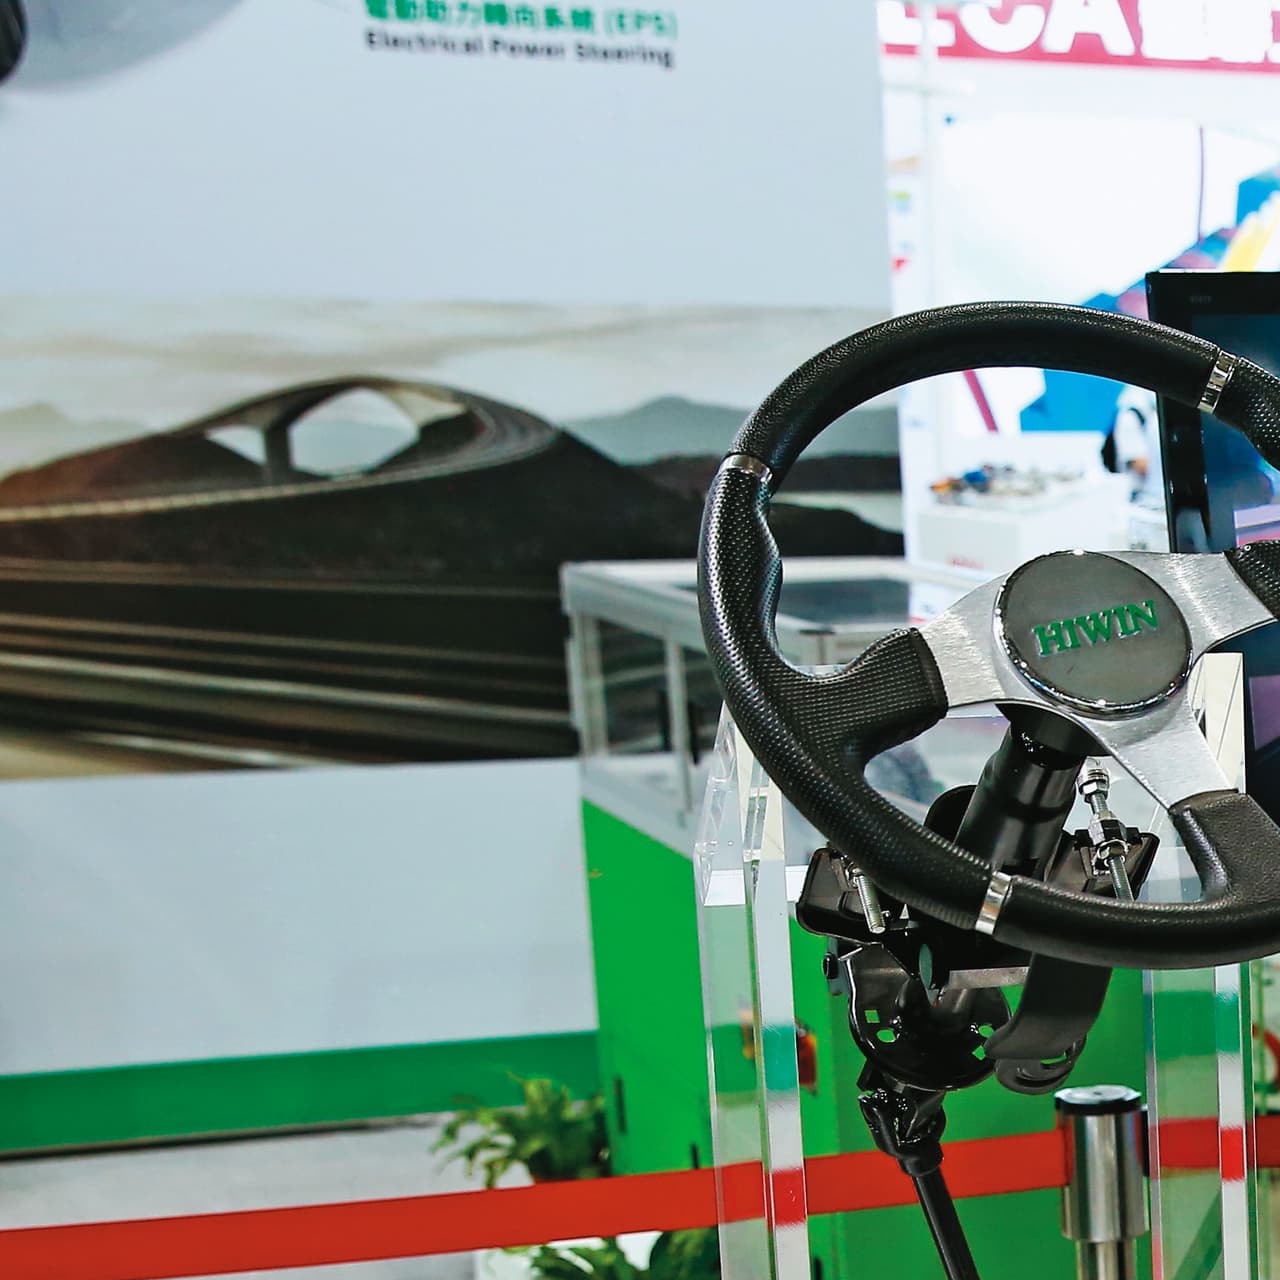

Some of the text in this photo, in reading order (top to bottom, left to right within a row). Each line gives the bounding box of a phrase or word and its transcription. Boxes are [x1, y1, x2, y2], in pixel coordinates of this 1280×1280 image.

[366, 27, 676, 69] Electrical Power Steering
[1032, 599, 1160, 657] HIWIN
